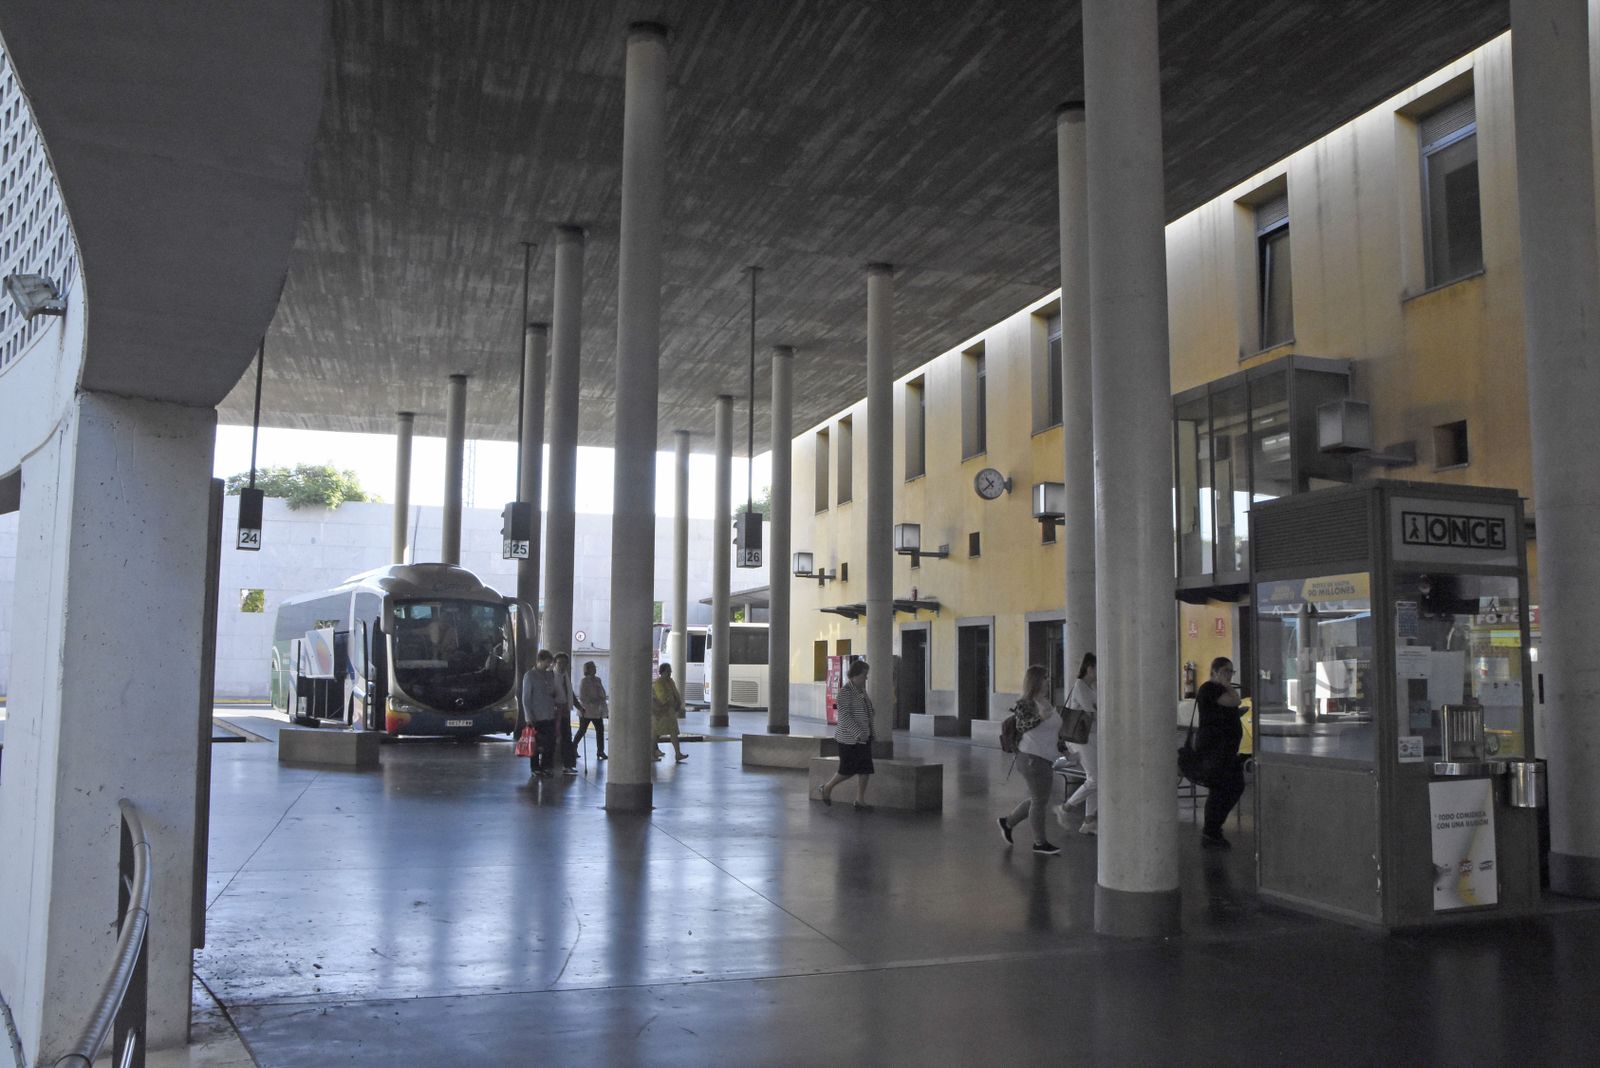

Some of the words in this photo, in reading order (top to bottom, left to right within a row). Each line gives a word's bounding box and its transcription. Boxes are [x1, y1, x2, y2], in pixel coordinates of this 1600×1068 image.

[1429, 518, 1502, 545] ONCE
[241, 532, 258, 544] 24
[513, 543, 528, 555] 25
[747, 551, 760, 562] 26
[1318, 585, 1355, 596] MILLONES
[1439, 813, 1455, 821] TODO
[1437, 822, 1450, 830] CON
